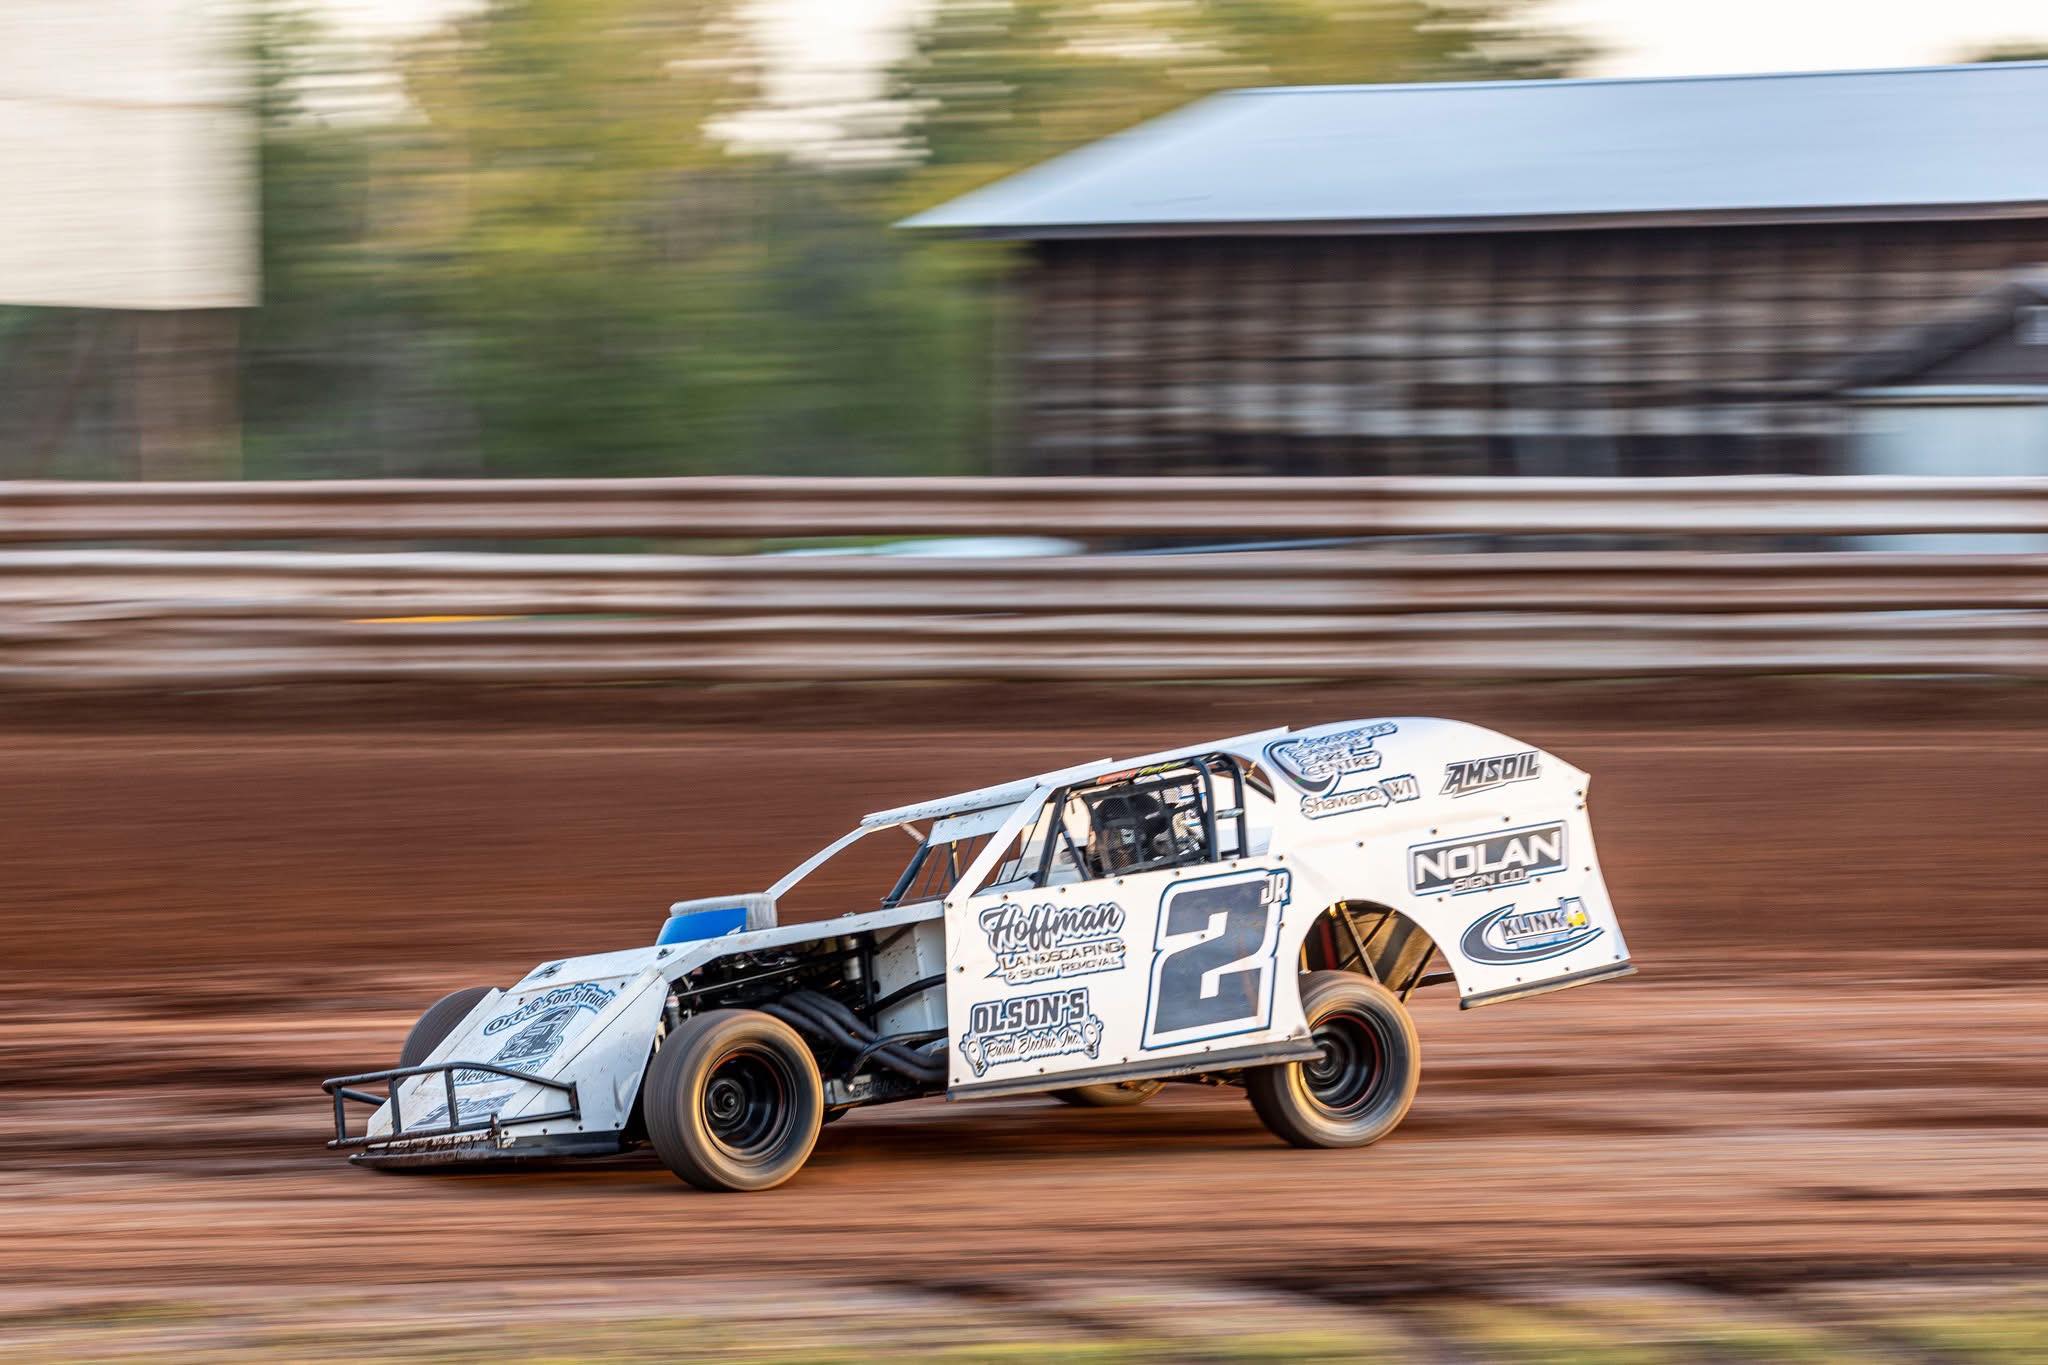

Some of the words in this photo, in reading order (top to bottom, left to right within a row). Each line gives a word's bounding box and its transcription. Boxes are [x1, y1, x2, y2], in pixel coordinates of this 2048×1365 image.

[1386, 779, 1413, 797] WI
[1446, 751, 1539, 791] AMSOIL
[1415, 831, 1561, 885] NOLAN
[1453, 872, 1496, 891] SIGN
[983, 905, 1121, 950] Hoffman
[1501, 911, 1563, 937] KLINK
[1002, 941, 1121, 970] LANDSCAPING
[1020, 964, 1055, 980] SNOW
[1061, 956, 1119, 974] REMOVAL
[1153, 879, 1269, 1034] 2
[1260, 873, 1288, 905] JR
[489, 1009, 520, 1031] Ort
[526, 1000, 541, 1016] &
[544, 988, 579, 1009] Son's
[974, 991, 1084, 1034] OLSON'S
